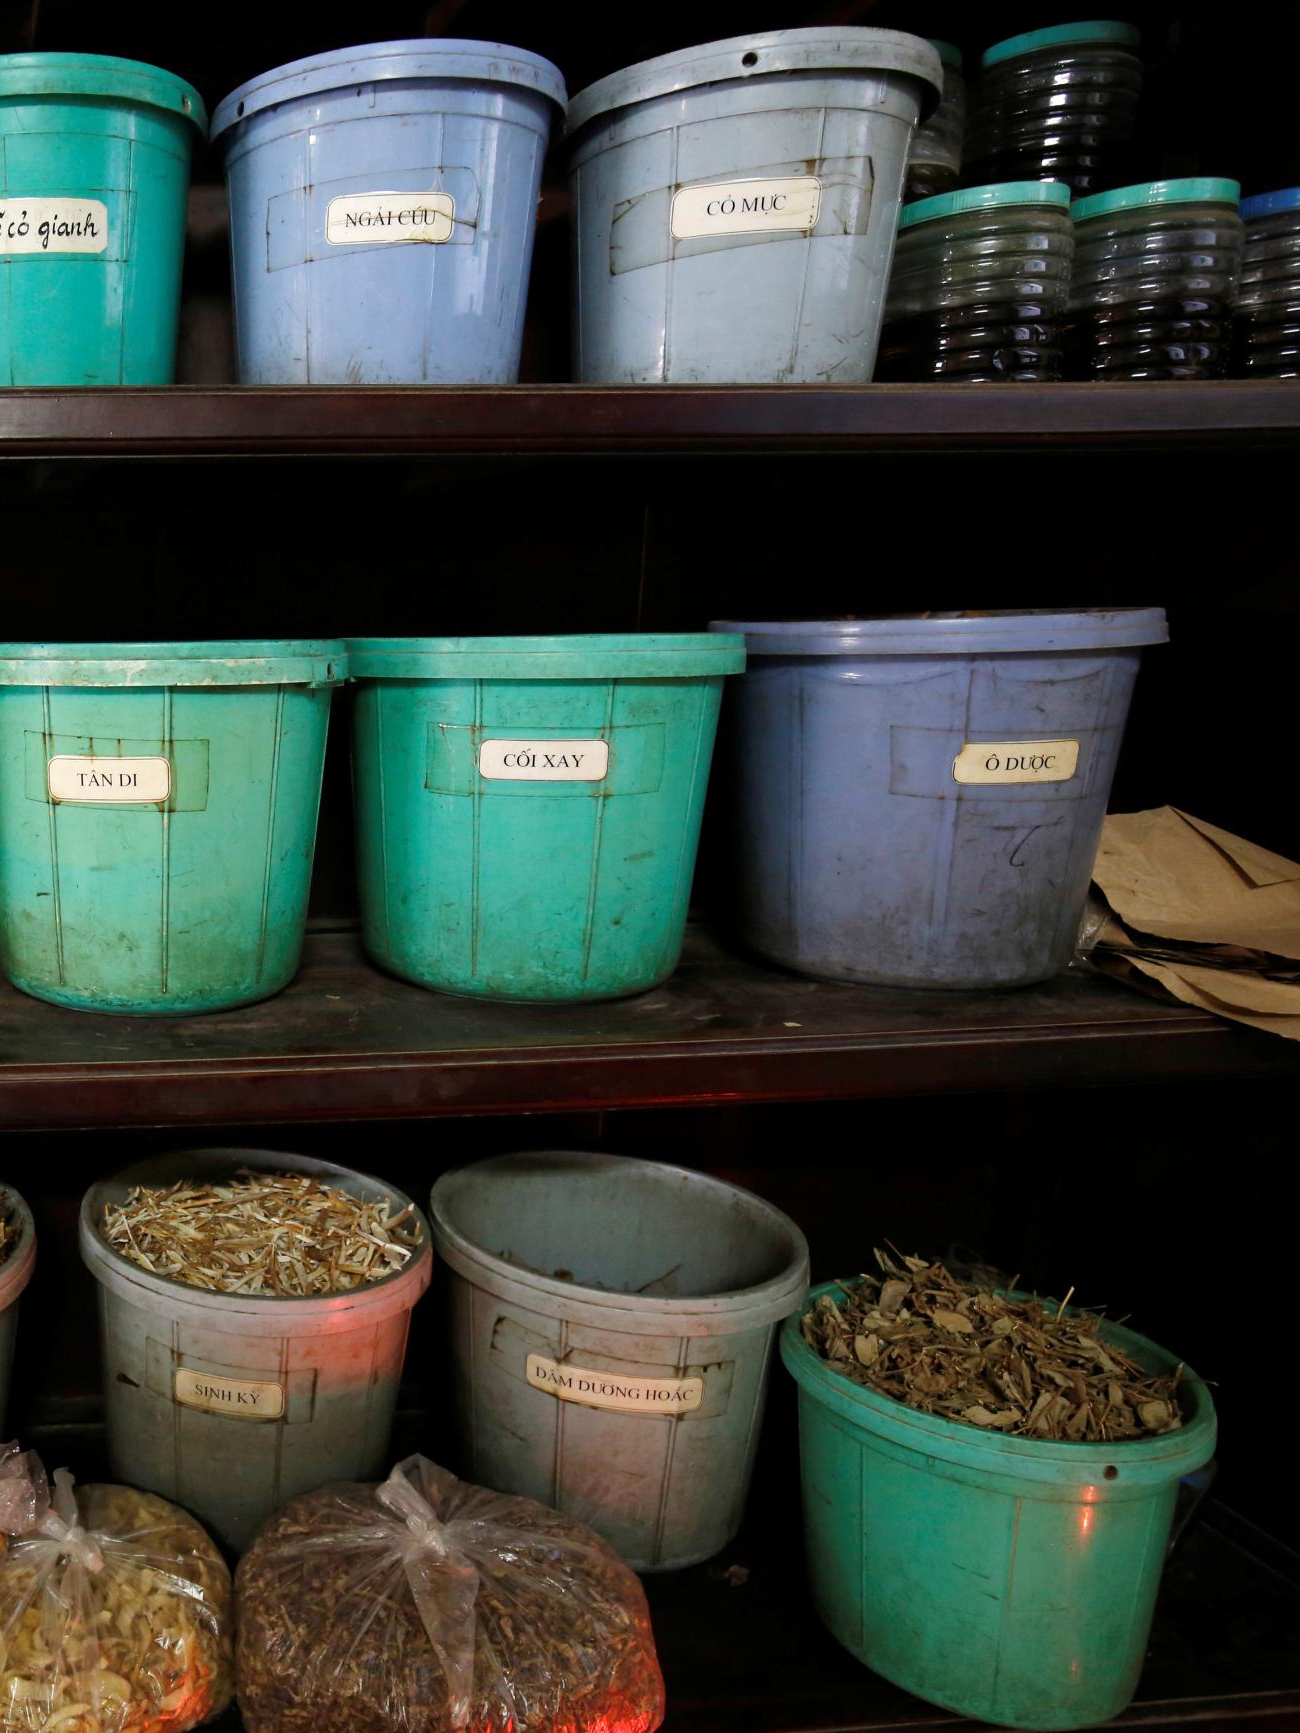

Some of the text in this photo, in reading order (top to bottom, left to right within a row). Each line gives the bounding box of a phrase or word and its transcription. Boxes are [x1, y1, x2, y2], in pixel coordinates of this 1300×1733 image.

[741, 193, 787, 216] MỰC
[397, 206, 436, 226] CỨU
[7, 210, 30, 239] cỏ
[38, 213, 98, 250] gianh
[503, 748, 585, 768] CỐI XAY
[985, 753, 1056, 773] Ô DƯỢC
[76, 769, 138, 787] TÂN DI
[195, 1384, 231, 1402] SINH
[578, 1379, 640, 1400] DƯƠNG
